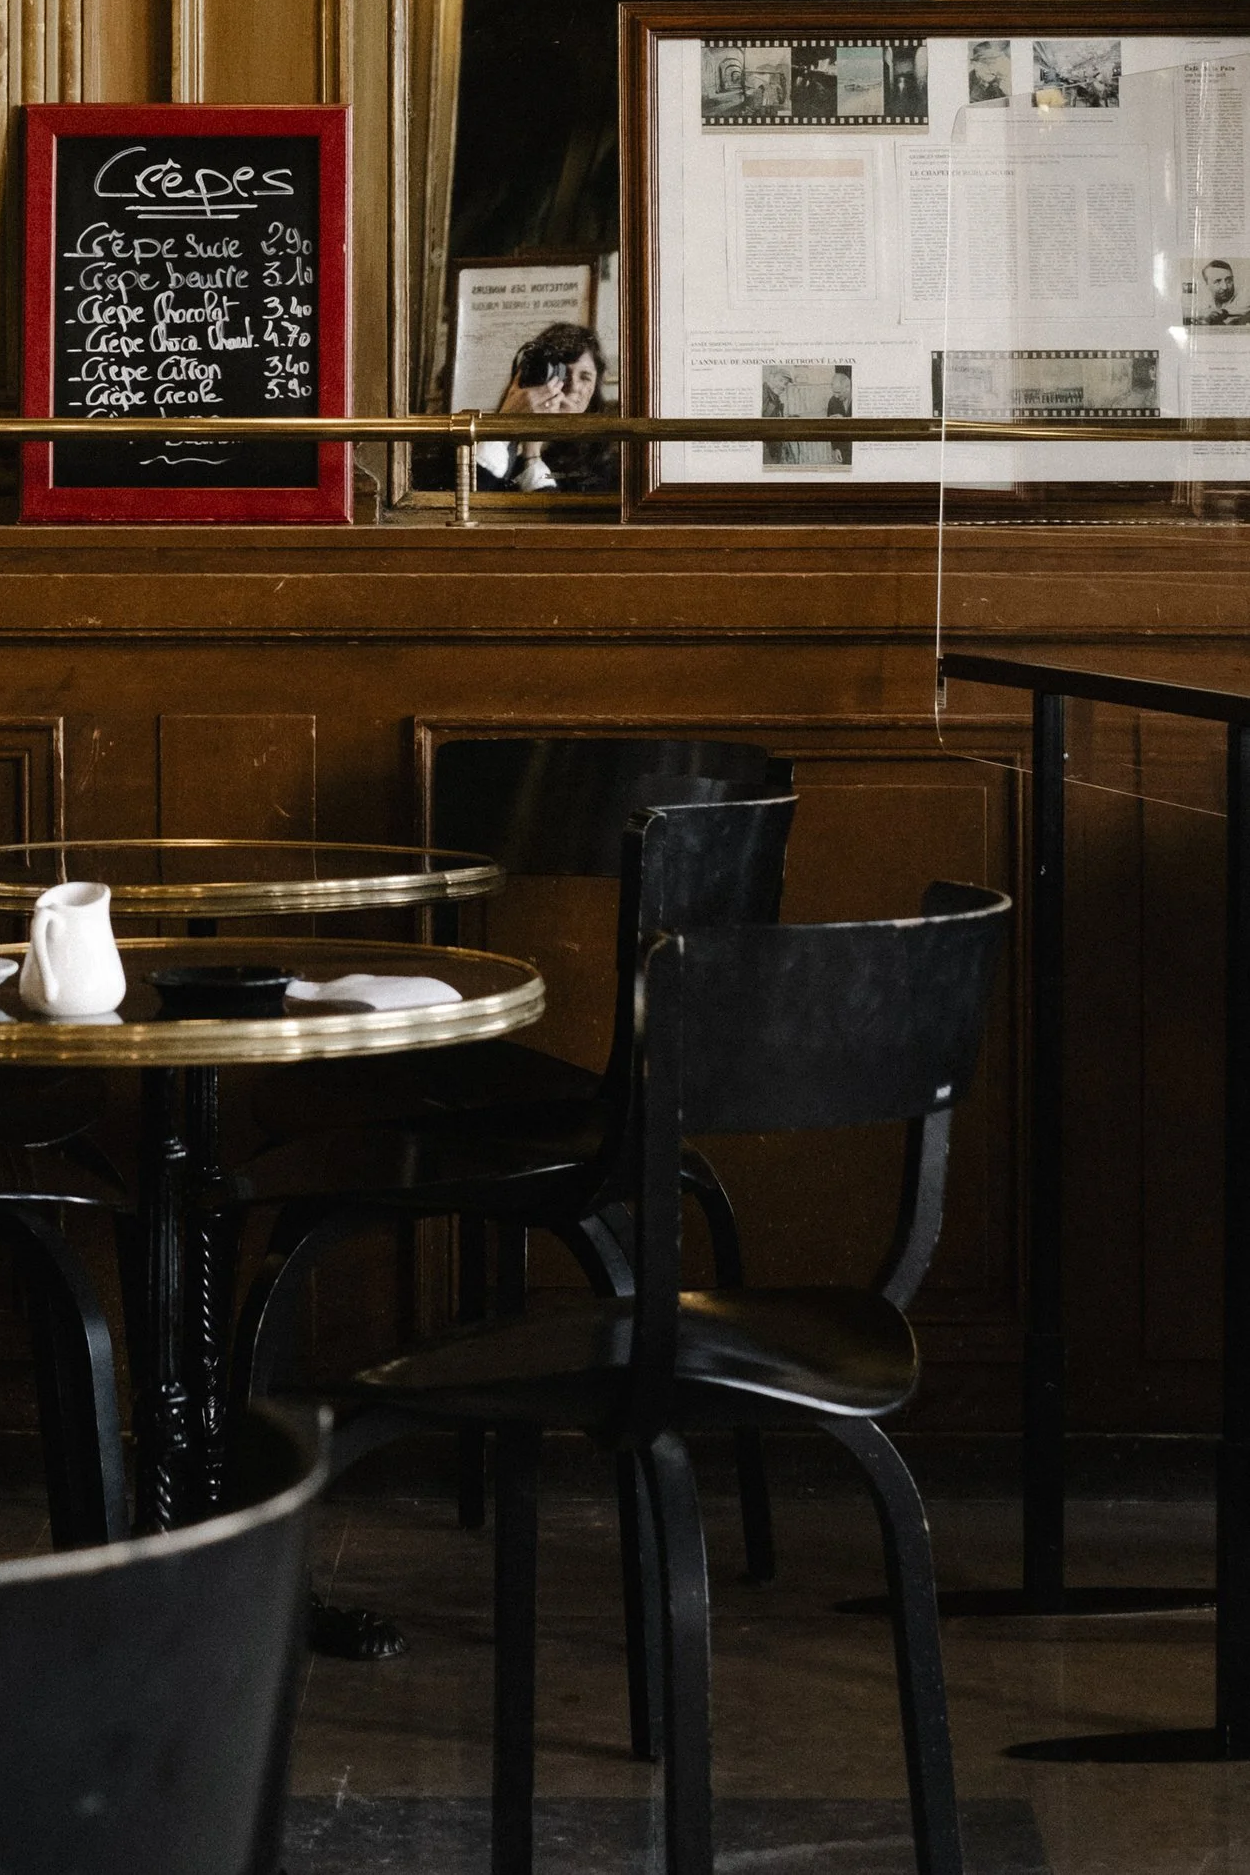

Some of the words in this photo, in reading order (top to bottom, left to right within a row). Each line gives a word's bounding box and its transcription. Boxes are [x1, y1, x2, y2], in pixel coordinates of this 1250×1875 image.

[93, 145, 296, 217] Crêpes
[75, 222, 177, 265] Crêpe
[261, 222, 313, 257] 2.90
[166, 262, 249, 290] beurre
[153, 290, 240, 324] Chocolat
[157, 355, 222, 382] Citron
[691, 357, 728, 366] L'ANNEAU
[730, 357, 739, 365] DE
[741, 357, 776, 365] SIMENON
[785, 356, 825, 365] RETROUVÉ
[827, 356, 838, 364] LA
[839, 356, 857, 364] PAIX
